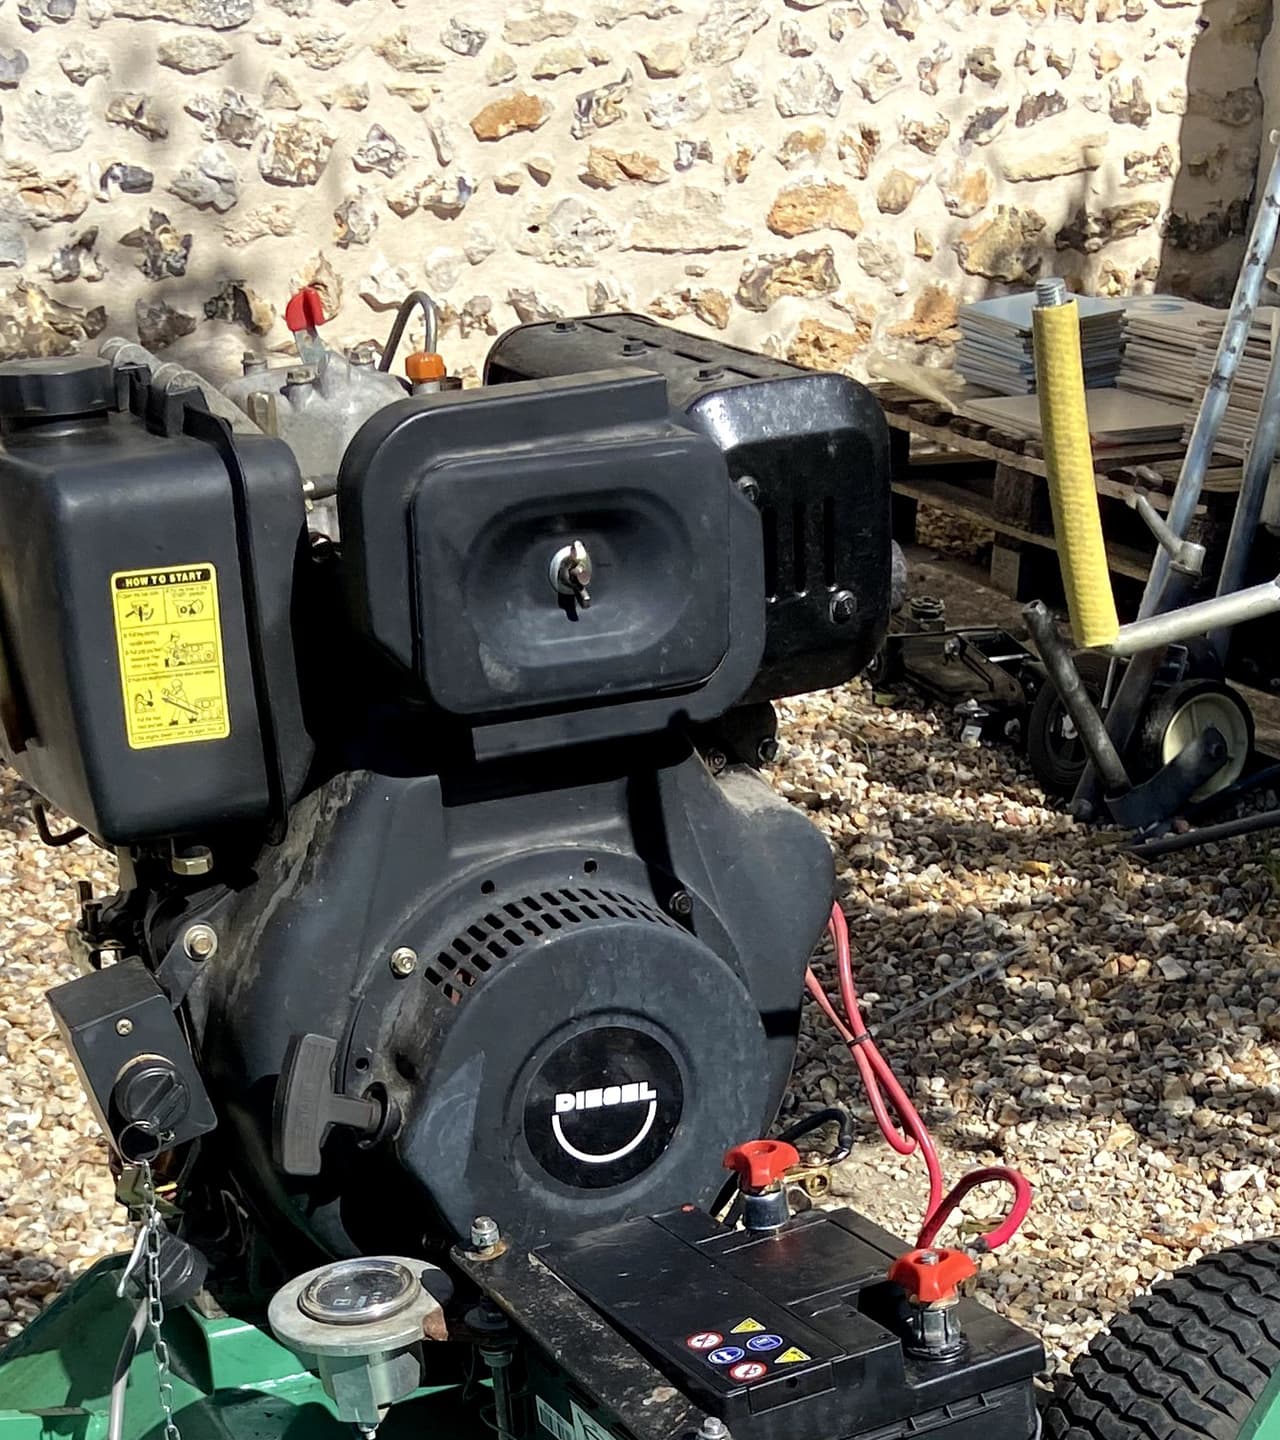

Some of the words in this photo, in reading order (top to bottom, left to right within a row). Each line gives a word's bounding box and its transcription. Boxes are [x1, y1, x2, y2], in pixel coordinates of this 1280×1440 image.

[125, 576, 148, 586] HOW
[150, 574, 166, 584] TO
[169, 571, 201, 582] START
[555, 1081, 657, 1114] DIESEL
